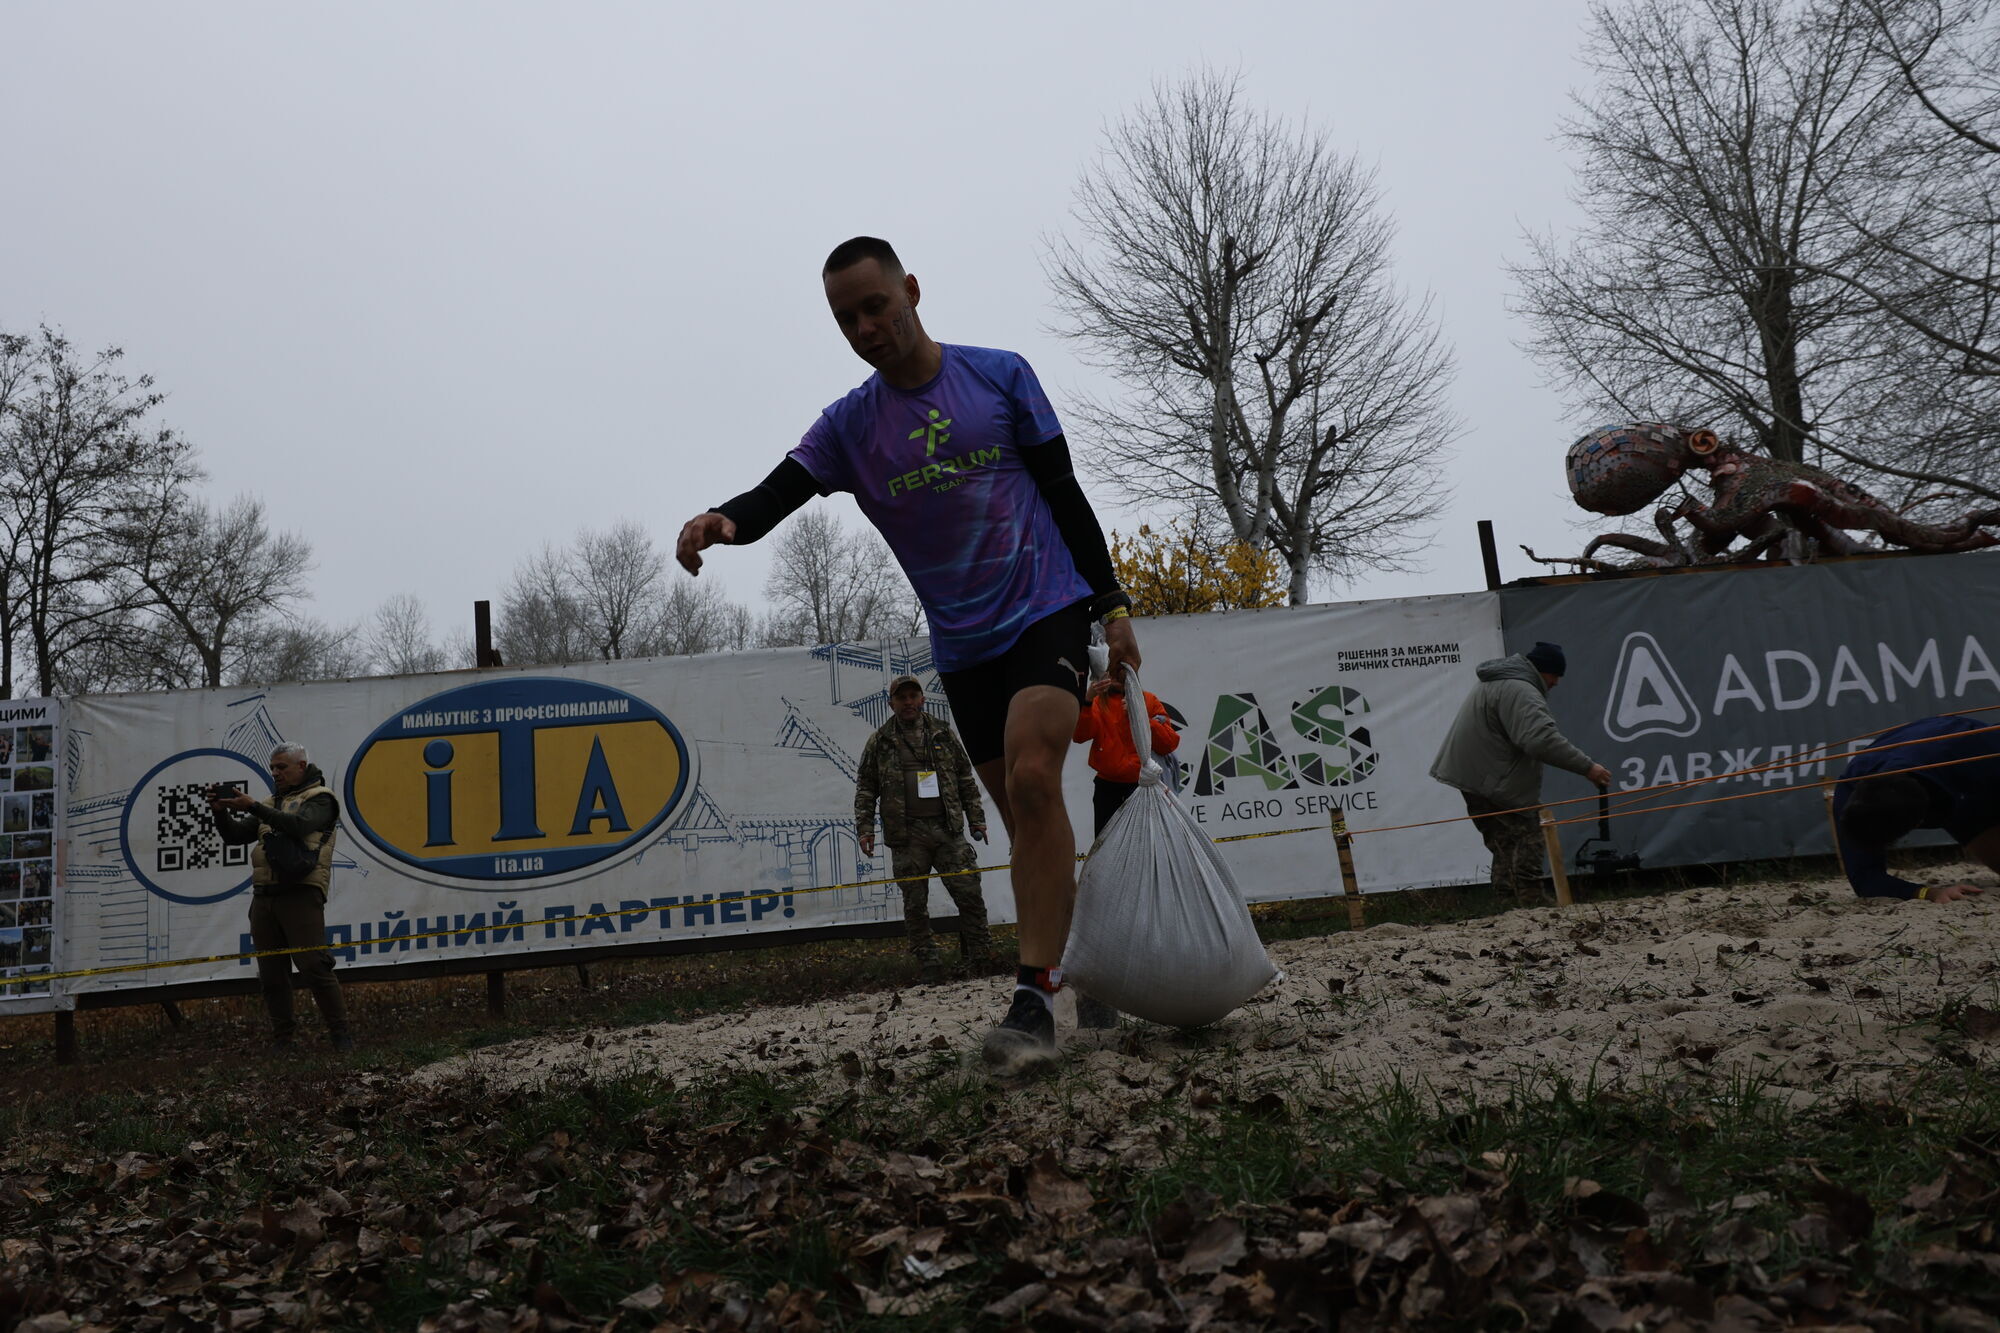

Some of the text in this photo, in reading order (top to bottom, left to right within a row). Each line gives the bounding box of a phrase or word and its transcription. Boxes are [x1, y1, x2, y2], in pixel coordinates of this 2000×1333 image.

[932, 476, 968, 494] TEAM
[1337, 643, 1460, 660] РІШЕННЯ ЗА МЕЖАМИ
[1338, 654, 1462, 672] ЗВИЧНИХ СТАНДАРТІВ!
[1712, 634, 2000, 716] ADAMA
[402, 699, 629, 729] МАЙБУТНЄ З ПРОФЕСІОНАЛАМИ
[1618, 742, 1827, 792] ЗАВЖДИ
[1221, 799, 1283, 822] AGRO
[1295, 791, 1378, 816] SERVICE
[494, 856, 544, 875] ita.ua
[240, 886, 796, 965] ДІЙНИЙ ПАРТНЕР!
